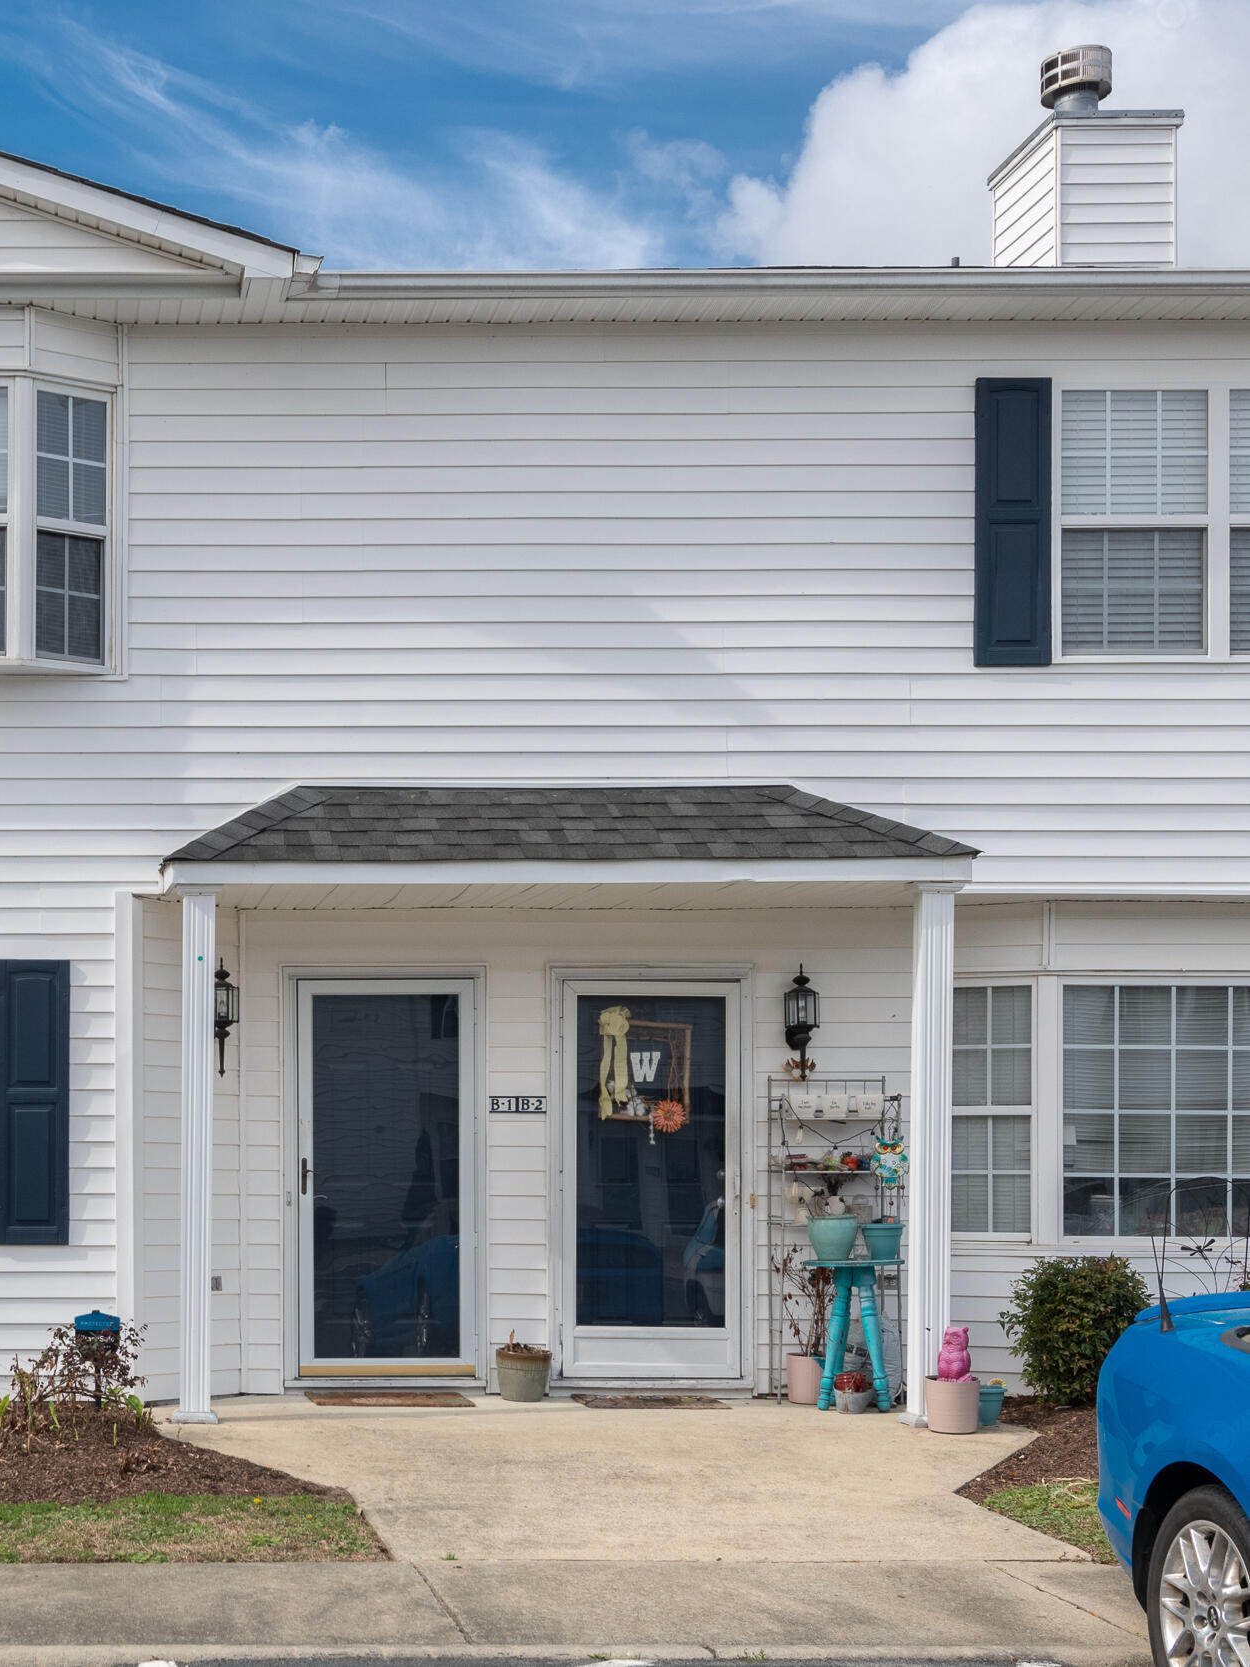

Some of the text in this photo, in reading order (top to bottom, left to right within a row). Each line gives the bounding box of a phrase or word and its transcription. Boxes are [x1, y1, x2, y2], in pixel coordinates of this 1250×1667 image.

[629, 1051, 661, 1082] W
[491, 1098, 512, 1111] B-1
[521, 1098, 543, 1111] B-2
